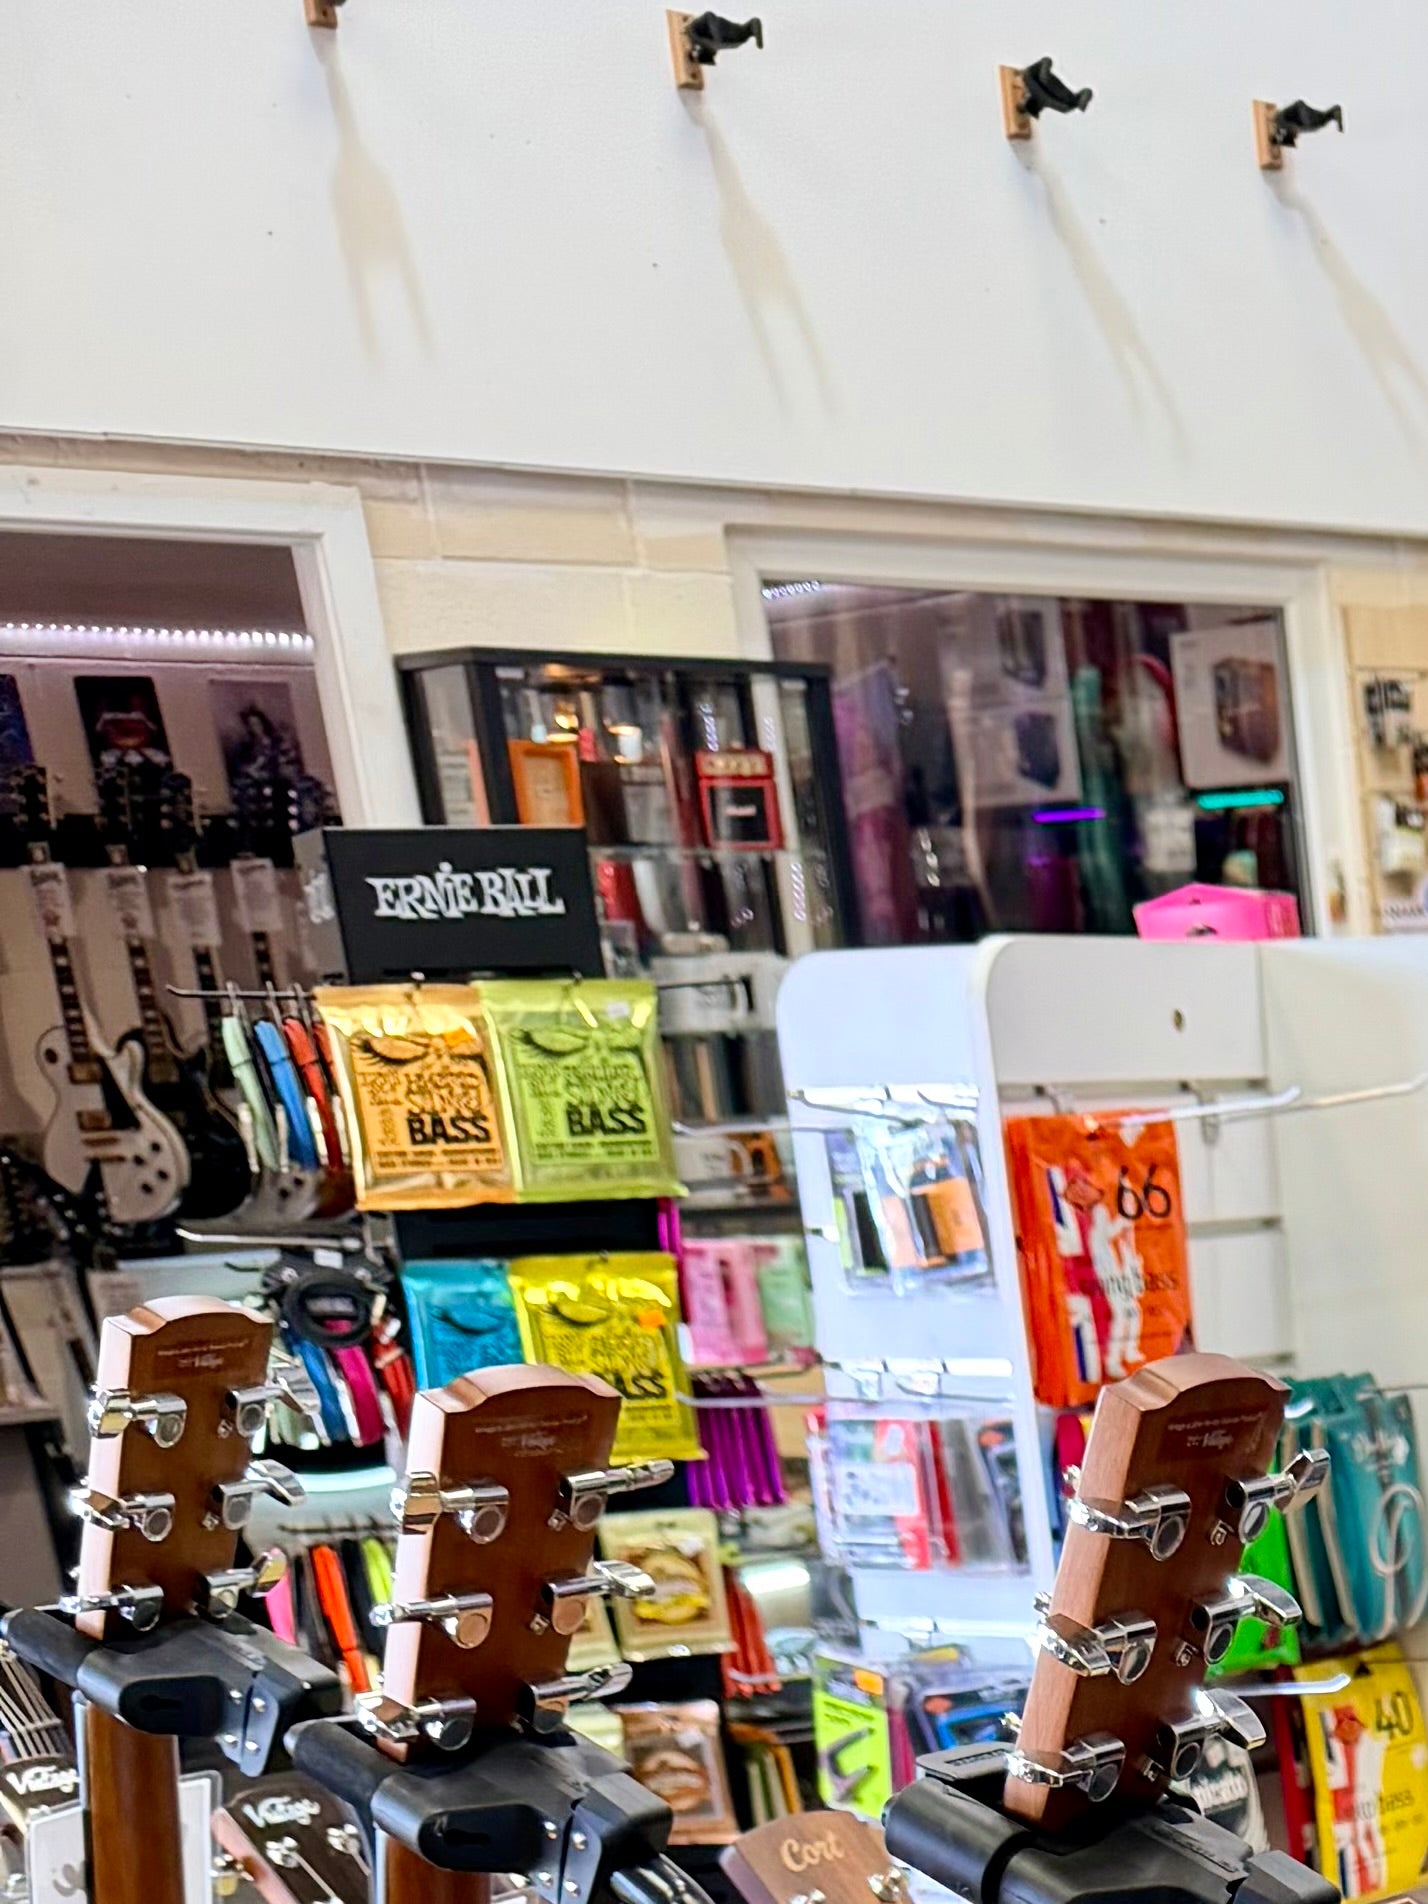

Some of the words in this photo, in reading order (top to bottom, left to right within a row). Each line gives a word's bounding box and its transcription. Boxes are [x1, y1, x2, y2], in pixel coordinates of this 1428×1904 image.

[366, 861, 480, 919] ERNIE
[478, 866, 565, 916] BALL
[409, 1112, 491, 1147] BASS
[566, 1101, 647, 1137] BASS
[1116, 1162, 1172, 1221] 66
[1373, 1690, 1415, 1741] 40
[780, 1829, 846, 1873] Cort
